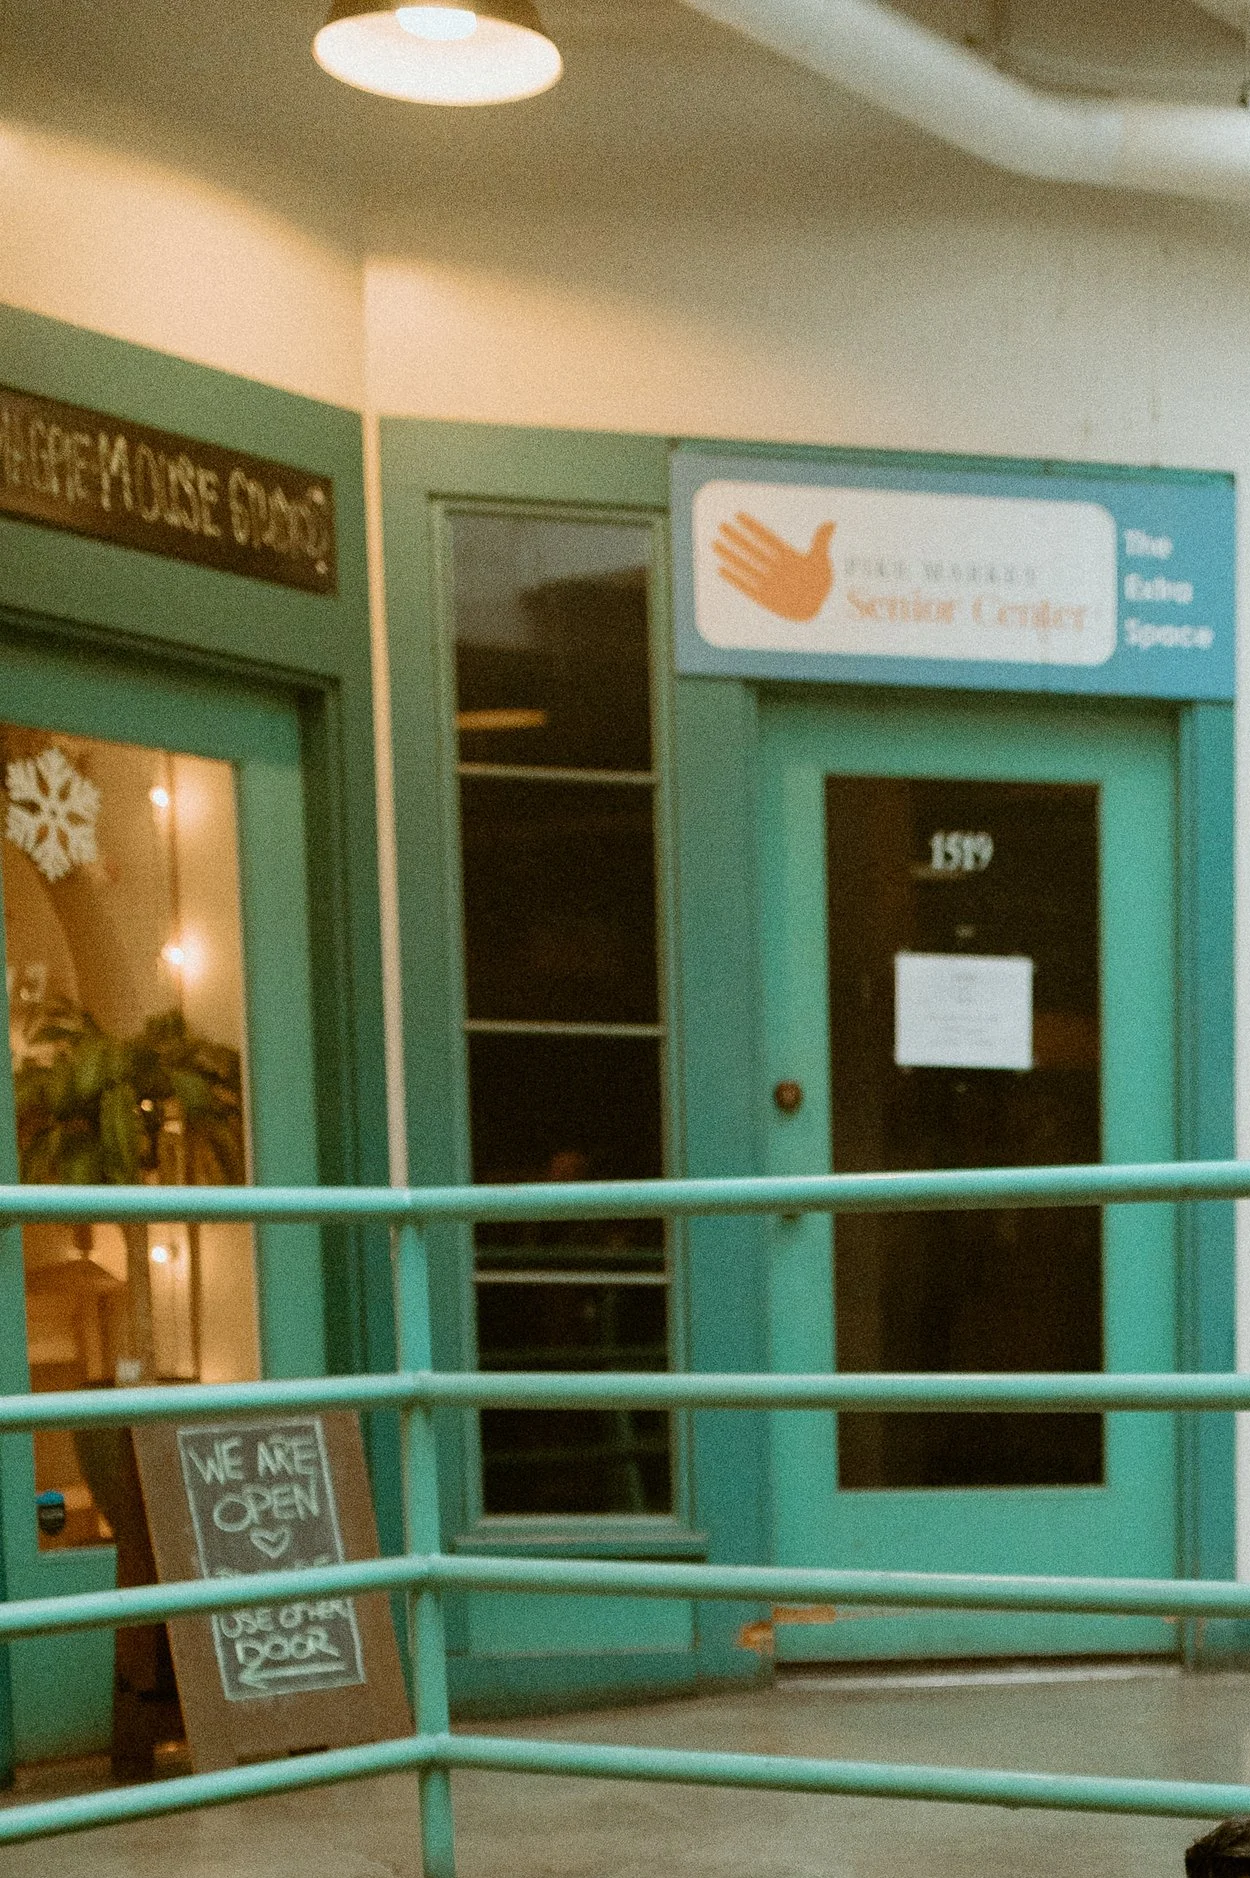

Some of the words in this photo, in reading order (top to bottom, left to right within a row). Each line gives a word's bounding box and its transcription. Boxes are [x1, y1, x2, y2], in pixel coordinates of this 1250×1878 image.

[1123, 529, 1173, 559] The
[846, 588, 958, 624] Senior
[970, 595, 1090, 632] Center
[1124, 616, 1215, 652] Space
[188, 1436, 245, 1485] WE
[256, 1432, 318, 1478] ARE
[212, 1474, 320, 1532] OPEN
[235, 1625, 341, 1667] DOOR
